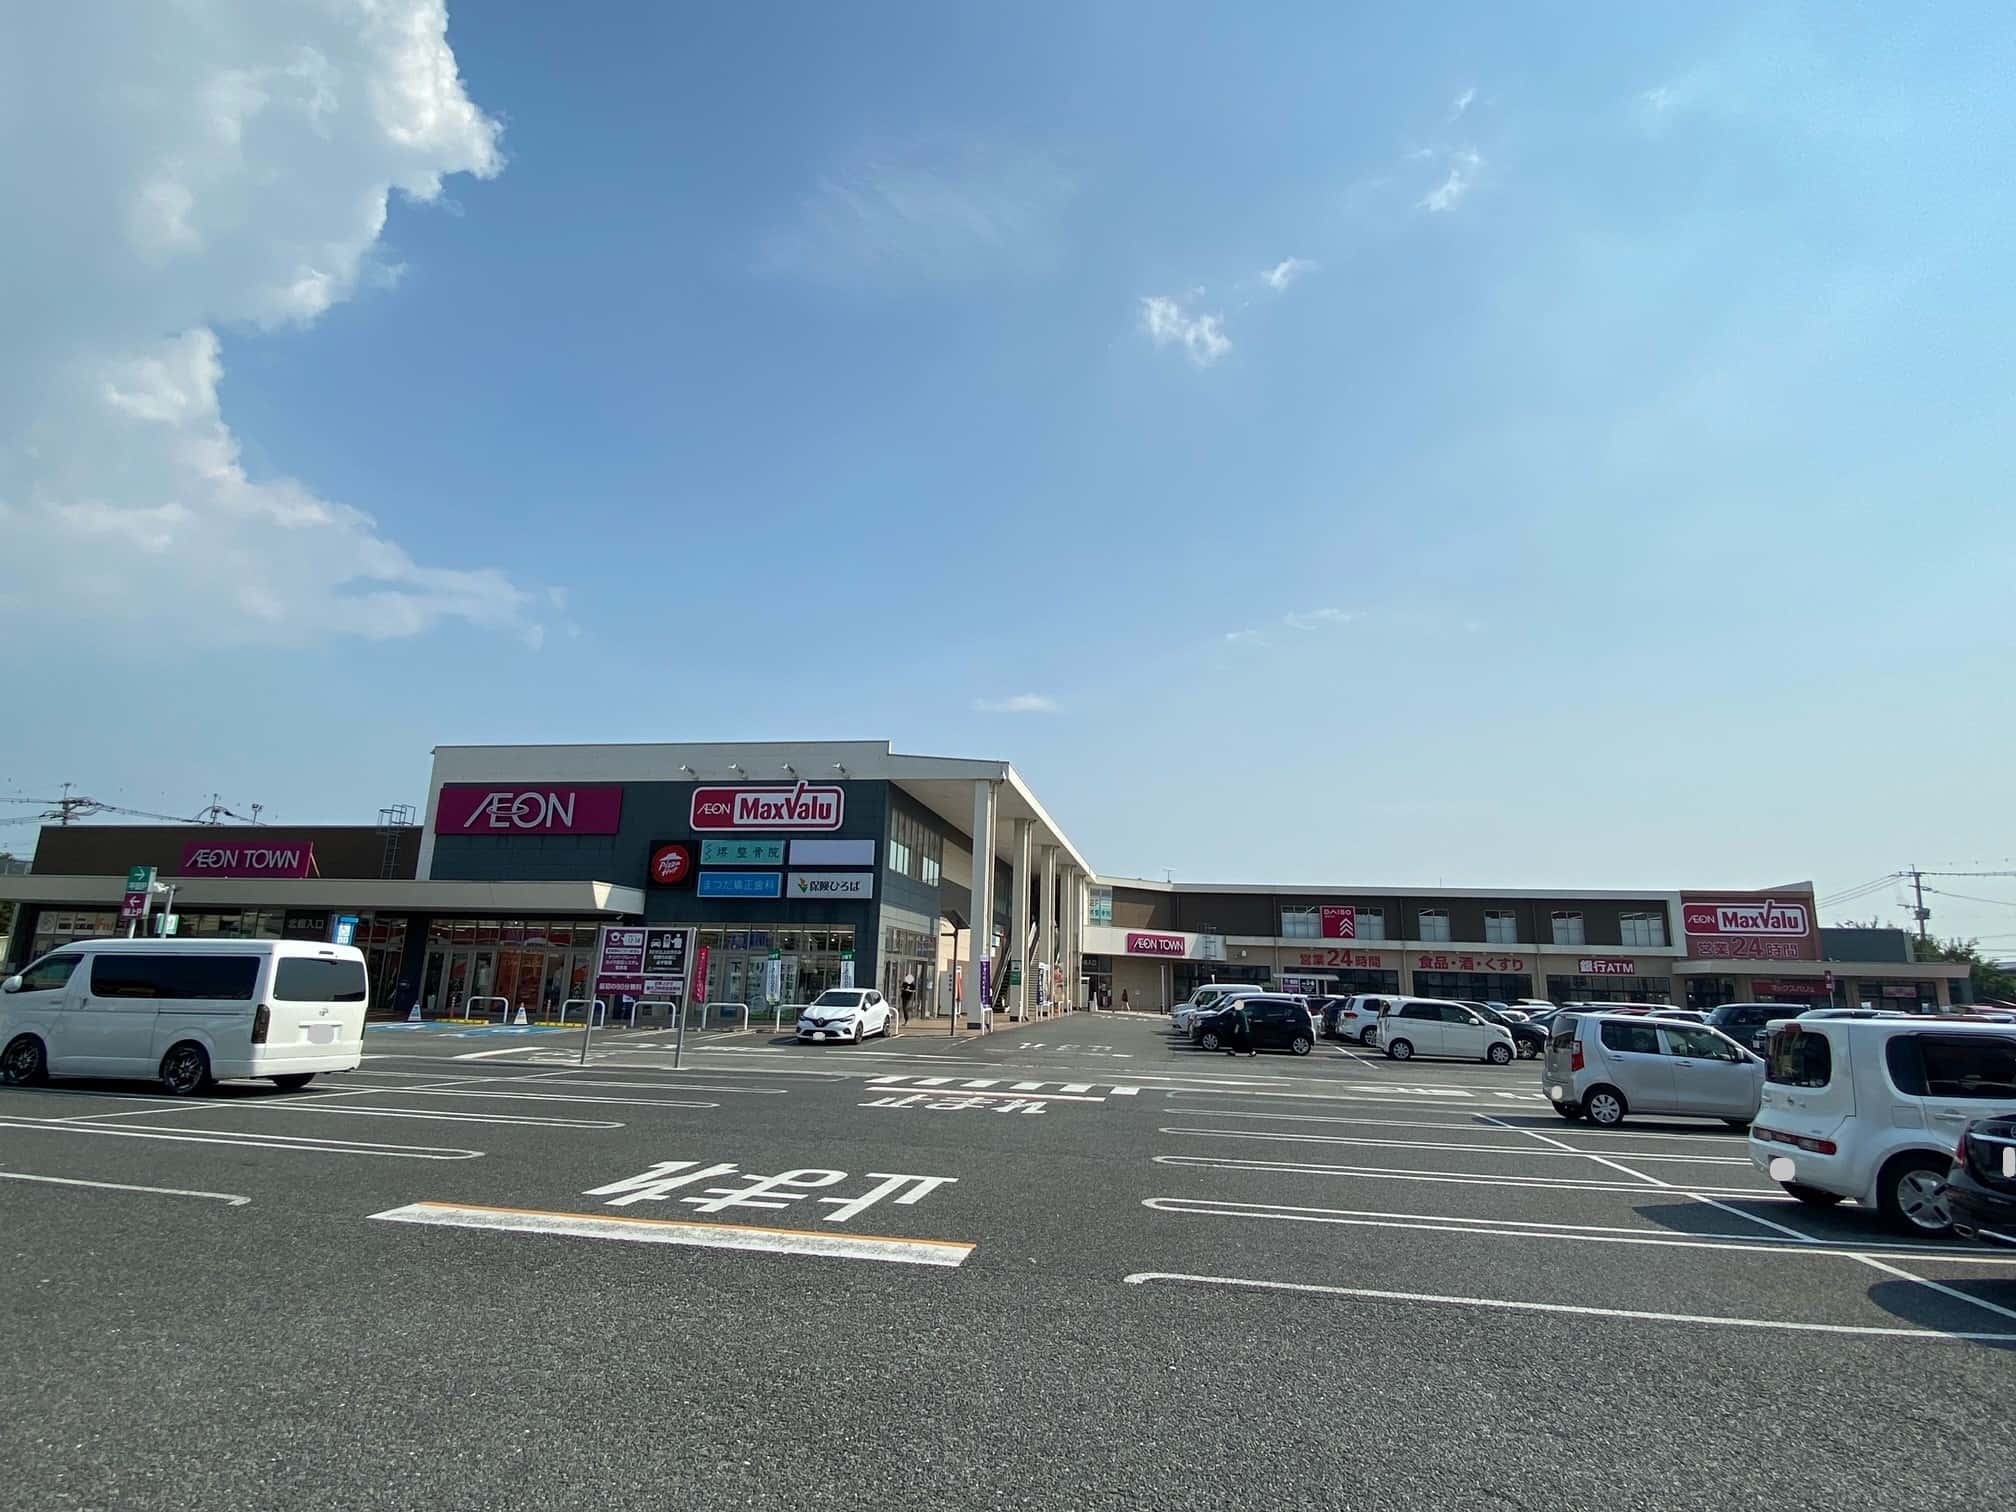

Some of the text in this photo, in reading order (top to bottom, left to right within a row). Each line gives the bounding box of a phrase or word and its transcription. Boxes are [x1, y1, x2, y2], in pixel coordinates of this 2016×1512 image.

[739, 781, 832, 821] MaxValu
[243, 849, 301, 869] TOWN
[658, 859, 681, 871] Pizza
[661, 866, 678, 877] Hut
[809, 880, 860, 892] 保険ひろば
[1323, 908, 1352, 916] DAISO
[1721, 901, 1798, 930] MaxValu
[1159, 938, 1184, 952] TOWN
[1696, 936, 1799, 959] 営業24時間
[1299, 949, 1381, 969] 営業24時間
[1579, 958, 1635, 974] 銀行ATM
[858, 1094, 1047, 1114] 止まれ
[581, 1161, 959, 1222] 止まれ
